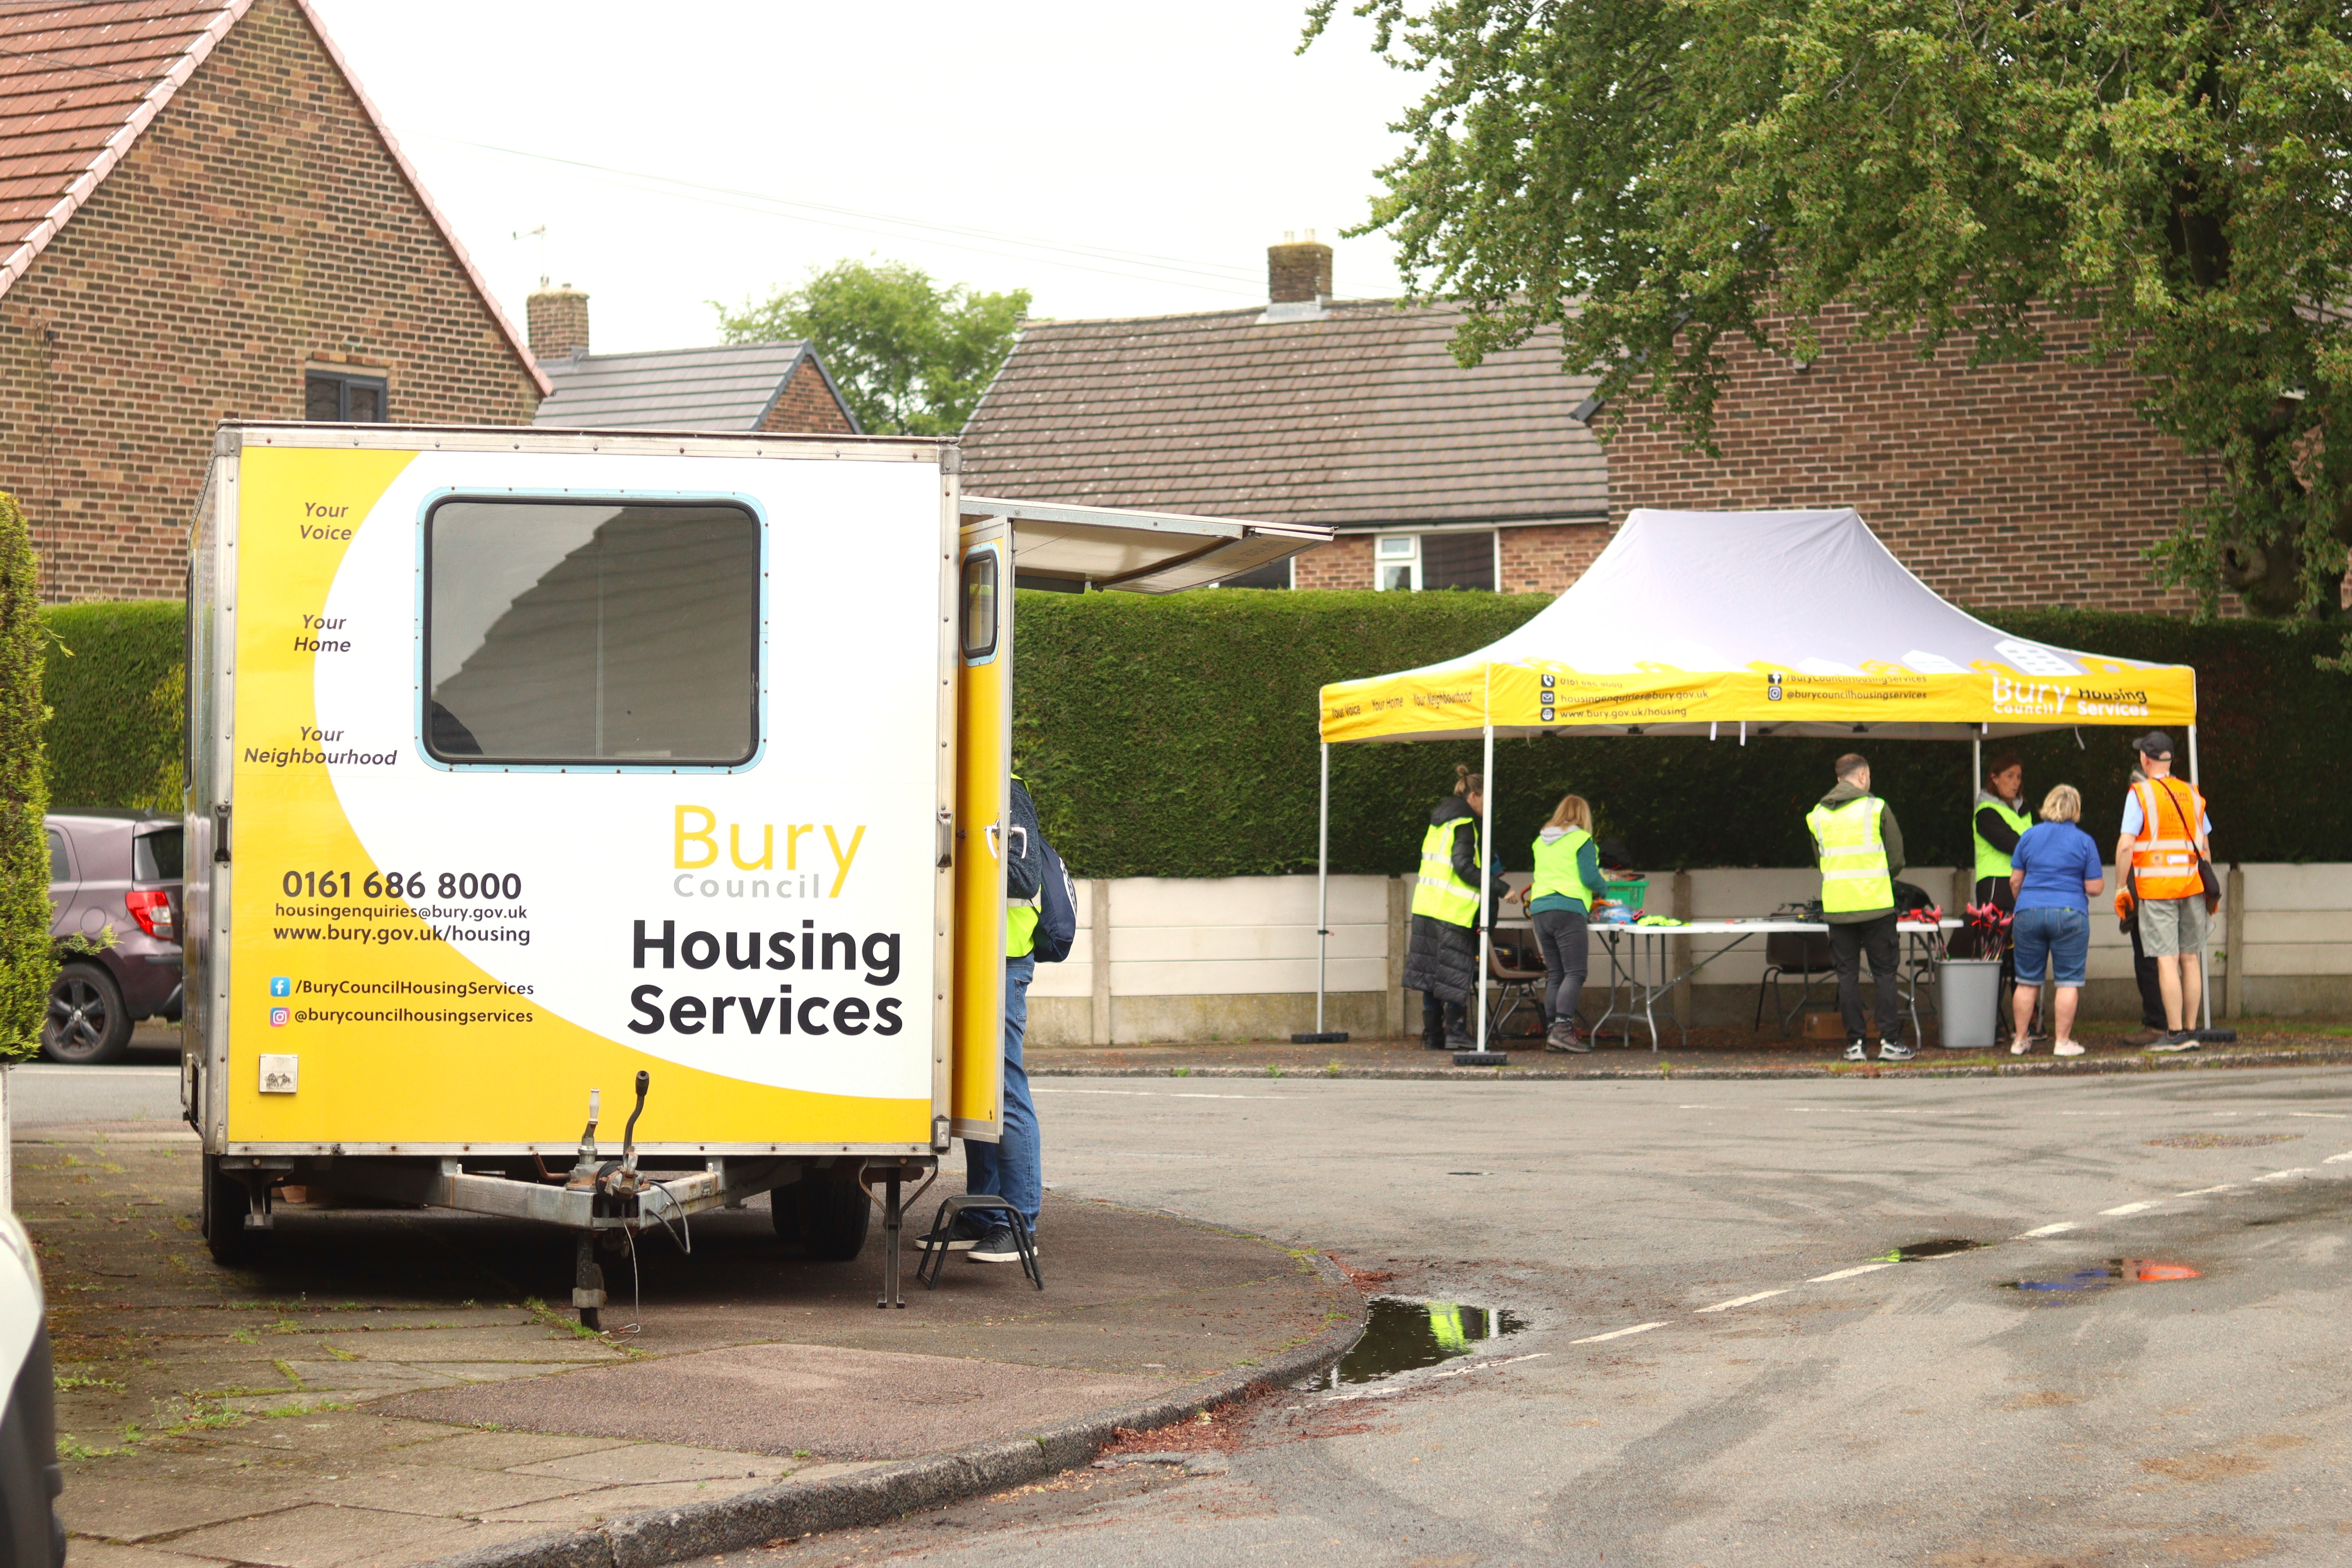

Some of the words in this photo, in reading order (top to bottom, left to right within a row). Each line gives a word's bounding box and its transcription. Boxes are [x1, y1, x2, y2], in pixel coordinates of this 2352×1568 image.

[305, 503, 348, 517] Your
[300, 524, 352, 540] Voice
[303, 615, 347, 630] Your
[294, 637, 351, 652] Home
[1371, 699, 1385, 711] Your
[1386, 696, 1403, 710] Home
[1413, 693, 1426, 707] Your
[1427, 690, 1472, 709] Neighbourhood
[1561, 690, 1709, 704] housingenquiries@bury.gov.uk
[1787, 690, 1927, 701] @burycouncilhousingservices
[1993, 677, 2070, 714] Bury
[2079, 689, 2148, 704] Housing
[1332, 706, 1344, 719] Your
[1345, 704, 1361, 718] Voice
[1560, 707, 1687, 719] www.bury.gov.uk/housing
[1993, 702, 2053, 714] Council
[2077, 701, 2149, 717] Services
[301, 726, 345, 742] Your
[245, 748, 397, 768] Neighbourhood
[675, 805, 866, 898] Bury
[283, 870, 350, 898] 0161
[363, 871, 425, 899] 686
[438, 873, 521, 900] 8000
[675, 873, 819, 898] Council
[276, 903, 527, 922] housingenquiries@bury.gov.uk
[274, 924, 530, 946] www.bury.gov.uk/housing
[633, 919, 900, 986] Housing
[296, 980, 534, 998] /BuryCouncilHousingServices
[295, 1007, 533, 1025] @burycouncilhousingservices
[627, 984, 903, 1036] Services
